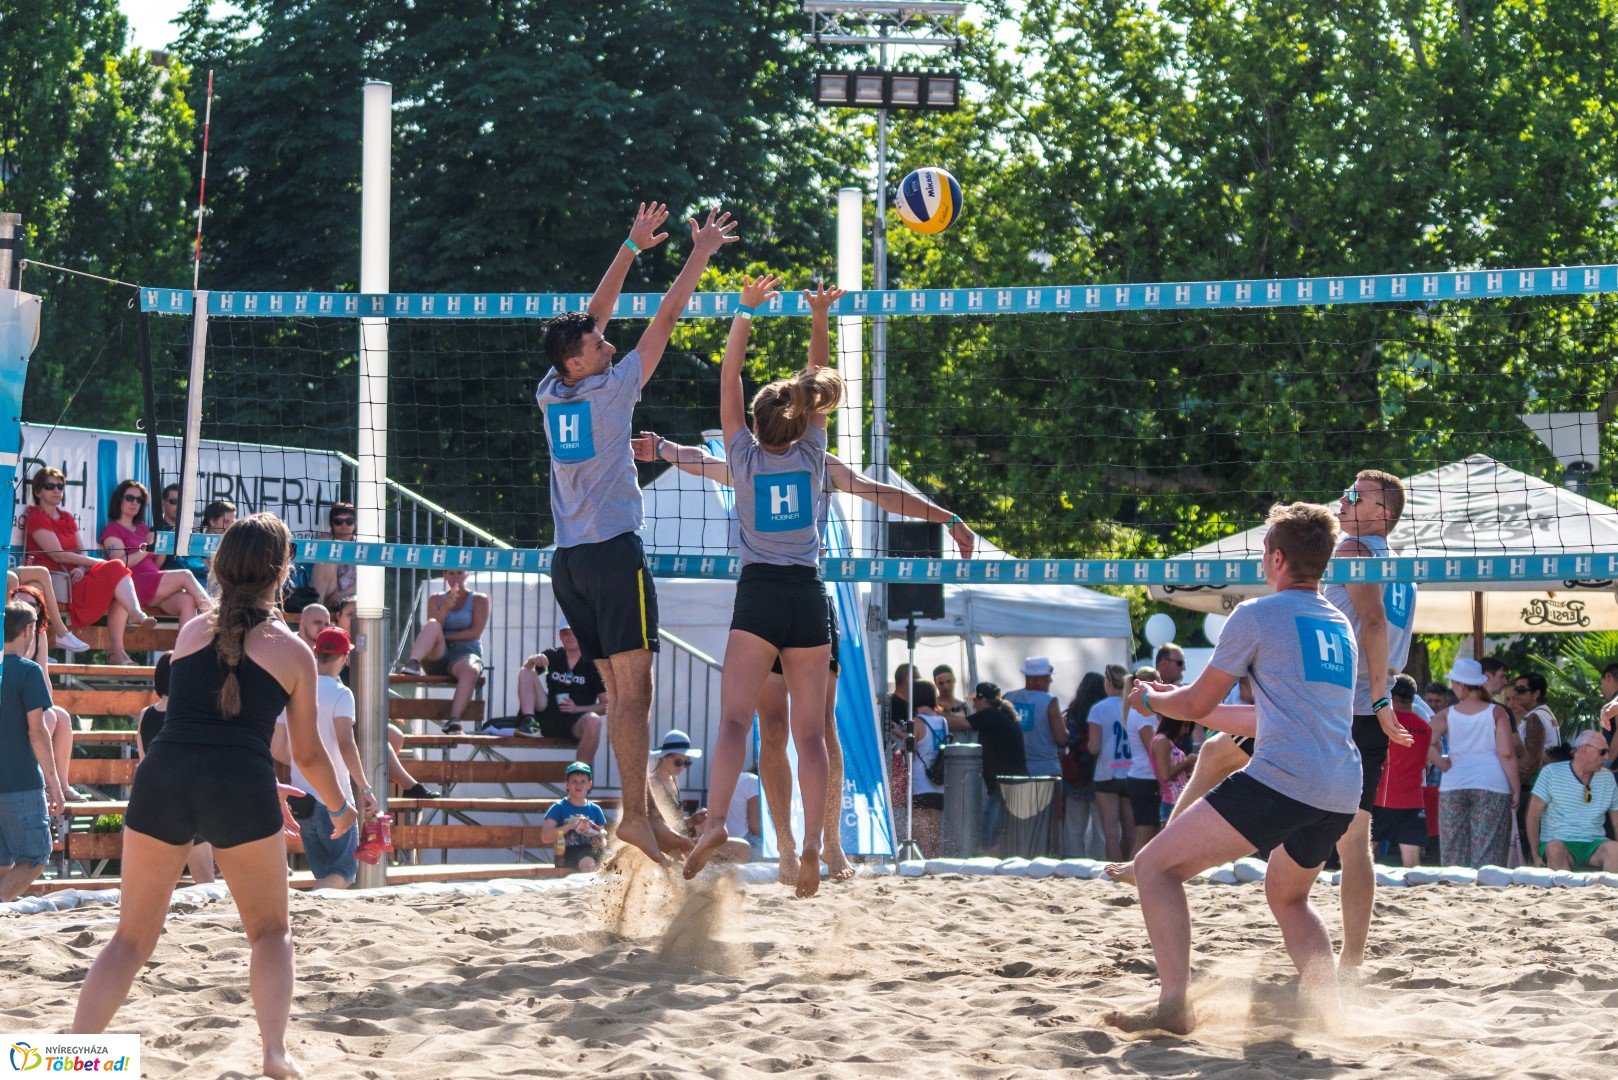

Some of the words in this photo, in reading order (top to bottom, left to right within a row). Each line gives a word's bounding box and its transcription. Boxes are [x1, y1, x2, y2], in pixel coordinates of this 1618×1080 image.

[170, 292, 183, 306] H
[221, 294, 233, 308] H
[245, 295, 257, 308] H
[270, 295, 282, 309] H
[296, 295, 307, 309] H
[320, 296, 332, 310] H
[346, 296, 358, 310] H
[372, 297, 383, 310] H
[396, 296, 408, 310] H
[422, 296, 434, 311] H
[448, 296, 460, 311] H
[474, 296, 486, 311] H
[500, 296, 512, 311] H
[526, 296, 539, 311] H
[553, 296, 567, 311] H
[632, 296, 646, 311] H
[688, 296, 702, 311] H
[714, 296, 728, 311] H
[854, 295, 868, 309] H
[882, 294, 896, 309] H
[911, 293, 925, 308] H
[940, 292, 954, 307] H
[968, 291, 982, 306] H
[998, 290, 1012, 306] H
[1026, 290, 1041, 305] H
[1056, 289, 1070, 304] H
[1086, 288, 1100, 304] H
[1116, 287, 1130, 303] H
[1145, 286, 1160, 302] H
[1176, 286, 1190, 301] H
[1206, 285, 1221, 300] H
[1236, 284, 1251, 299] H
[1267, 283, 1281, 298] H
[1298, 282, 1312, 297] H
[1329, 280, 1344, 296] H
[1360, 279, 1375, 295] H
[1392, 278, 1406, 293] H
[1423, 276, 1438, 292] H
[1455, 275, 1470, 291] H
[1487, 274, 1502, 290] H
[1519, 272, 1534, 289] H
[1552, 271, 1567, 287] H
[1584, 270, 1600, 286] H
[559, 414, 579, 442] H
[770, 484, 799, 514] H
[156, 534, 168, 548] H
[204, 537, 218, 550] H
[304, 542, 317, 556] H
[330, 544, 342, 558] H
[355, 545, 368, 559] H
[381, 546, 394, 560] H
[406, 547, 420, 561] H
[432, 548, 446, 563] H
[459, 550, 472, 564] H
[485, 551, 498, 565] H
[512, 552, 525, 566] H
[538, 552, 552, 567] H
[673, 558, 687, 571] H
[701, 558, 715, 572] H
[842, 561, 855, 575] H
[870, 561, 883, 576] H
[898, 562, 912, 576] H
[927, 562, 941, 577] H
[956, 562, 970, 577] H
[986, 563, 999, 577] H
[1015, 563, 1029, 578] H
[1044, 563, 1059, 578] H
[1074, 563, 1088, 578] H
[1104, 563, 1118, 578] H
[1134, 562, 1148, 578] H
[1164, 563, 1179, 578] H
[1195, 563, 1210, 578] H
[1226, 562, 1240, 578] H
[1350, 560, 1365, 576] H
[1382, 561, 1396, 576] H
[1414, 560, 1428, 576] H
[1446, 560, 1460, 576] H
[1478, 560, 1492, 575] H
[1510, 558, 1525, 574] H
[1543, 558, 1558, 573] H
[1576, 557, 1590, 572] H
[1392, 583, 1406, 610] H
[1316, 630, 1344, 664] H
[552, 672, 585, 684] adas
